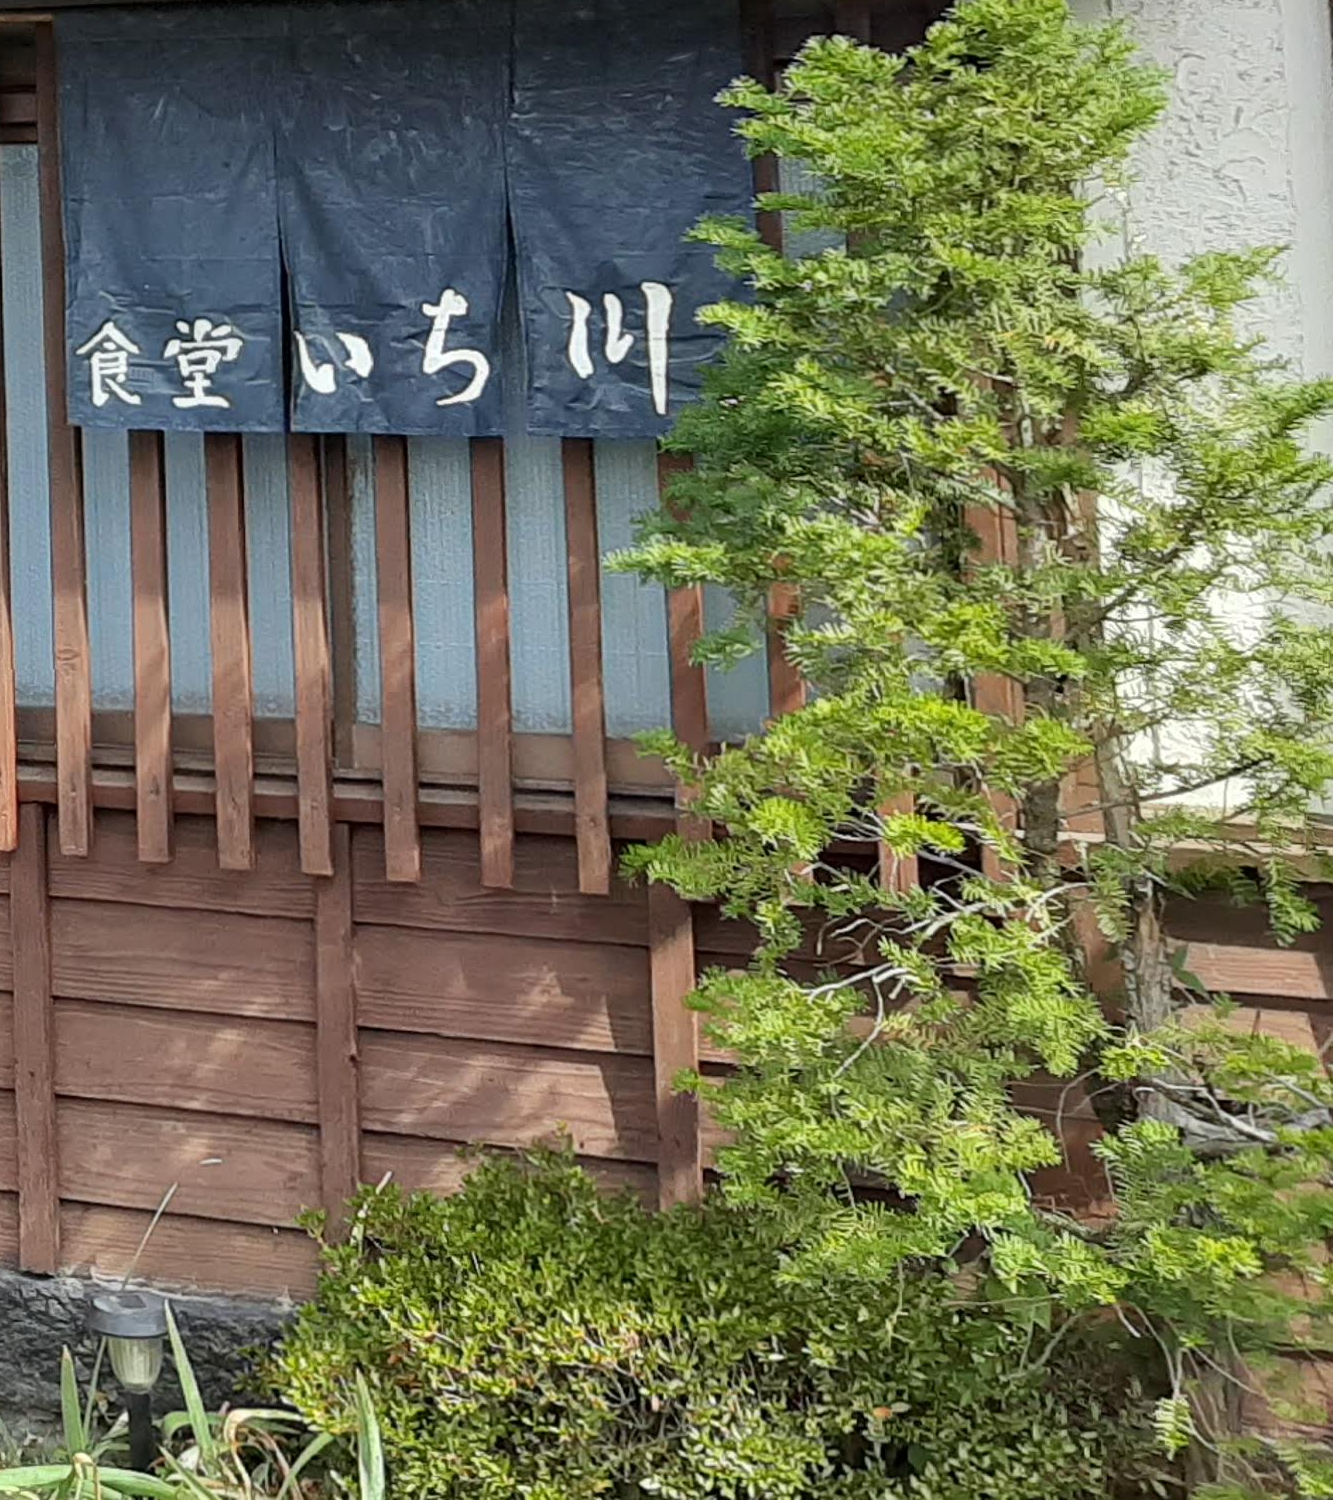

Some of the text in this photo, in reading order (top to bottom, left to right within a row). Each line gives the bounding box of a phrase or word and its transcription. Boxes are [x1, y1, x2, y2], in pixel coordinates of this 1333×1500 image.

[75, 280, 672, 417] 食堂 いち川
